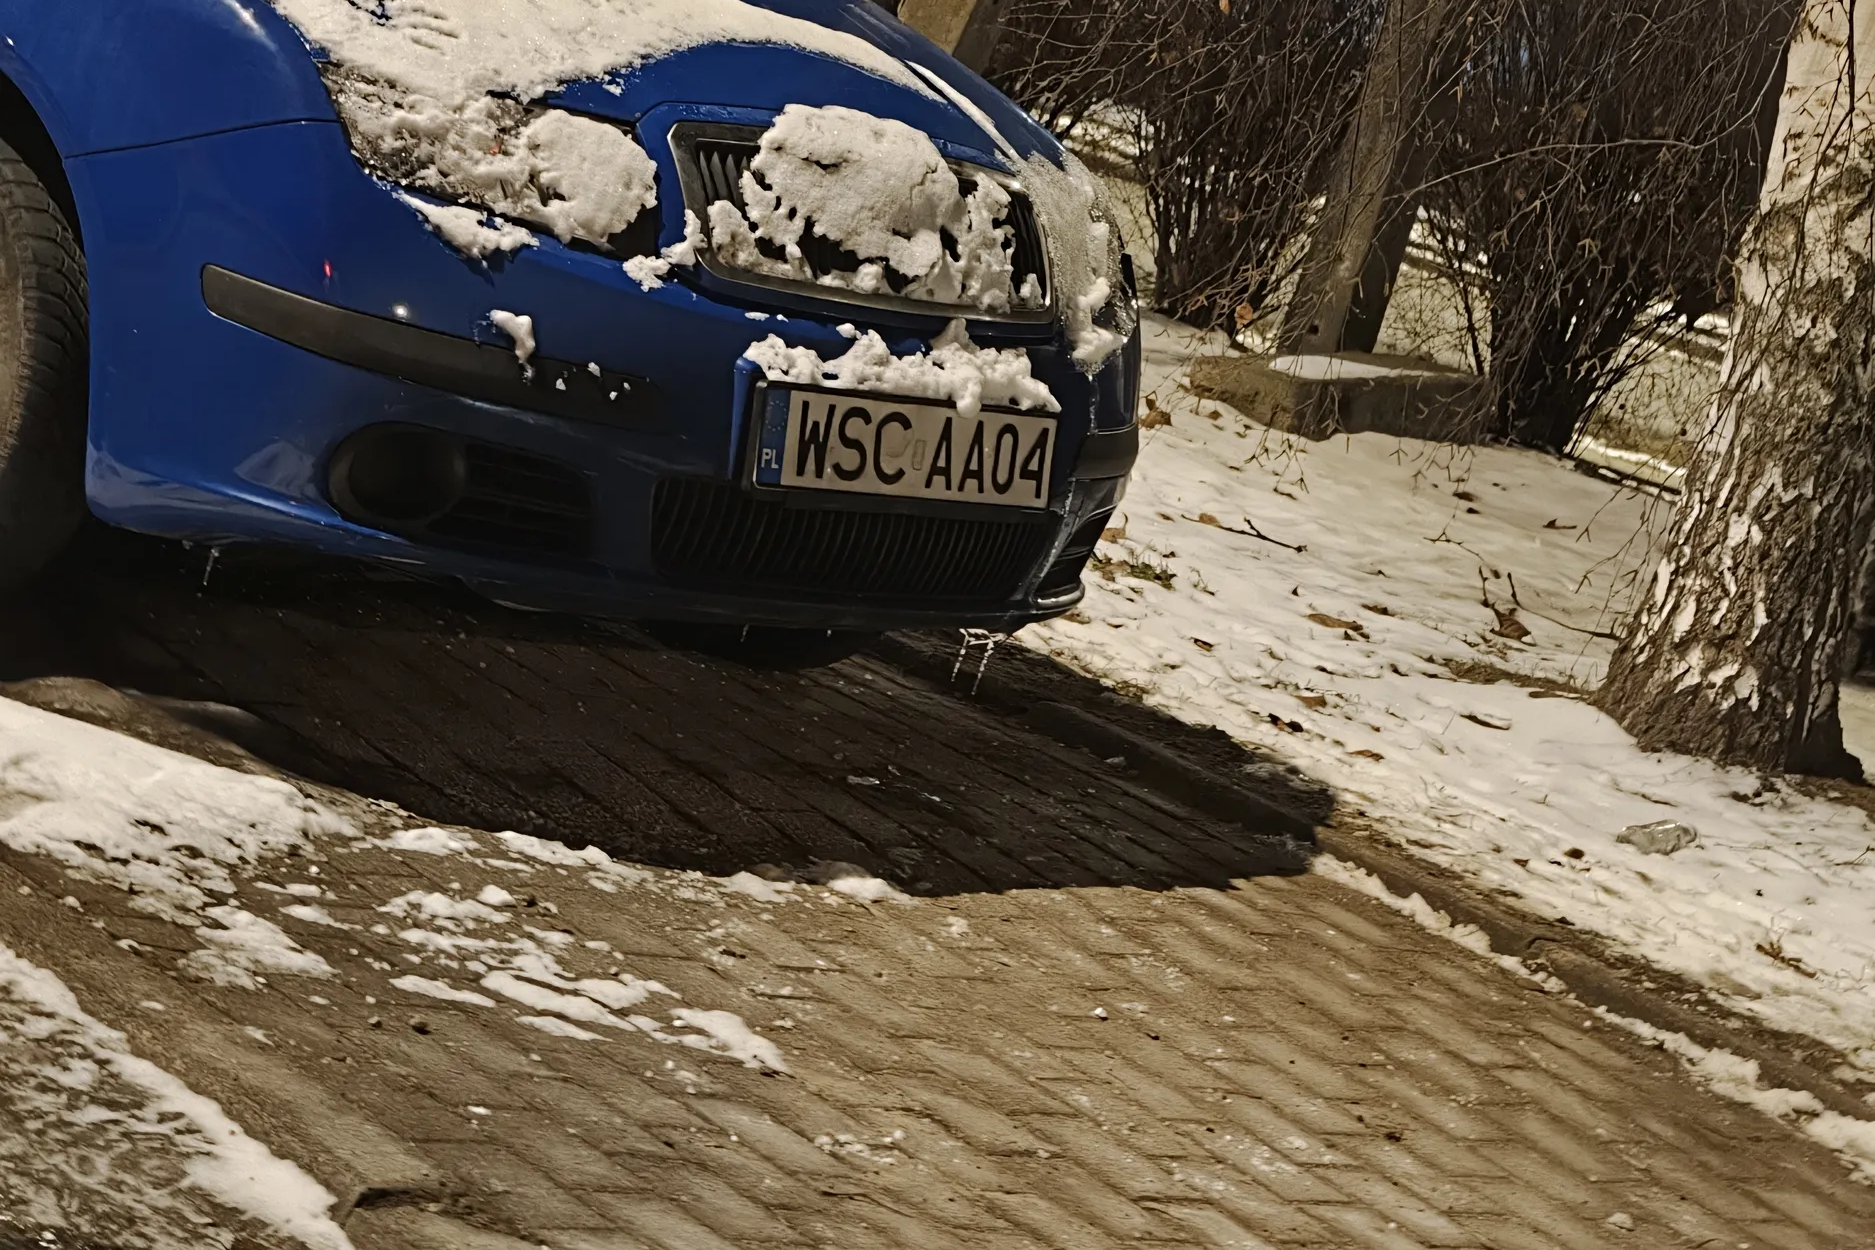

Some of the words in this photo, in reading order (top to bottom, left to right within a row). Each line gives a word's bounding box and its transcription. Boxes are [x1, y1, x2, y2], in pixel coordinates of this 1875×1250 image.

[761, 448, 779, 469] PL
[796, 400, 913, 485] WSC
[925, 416, 1049, 499] AA04
